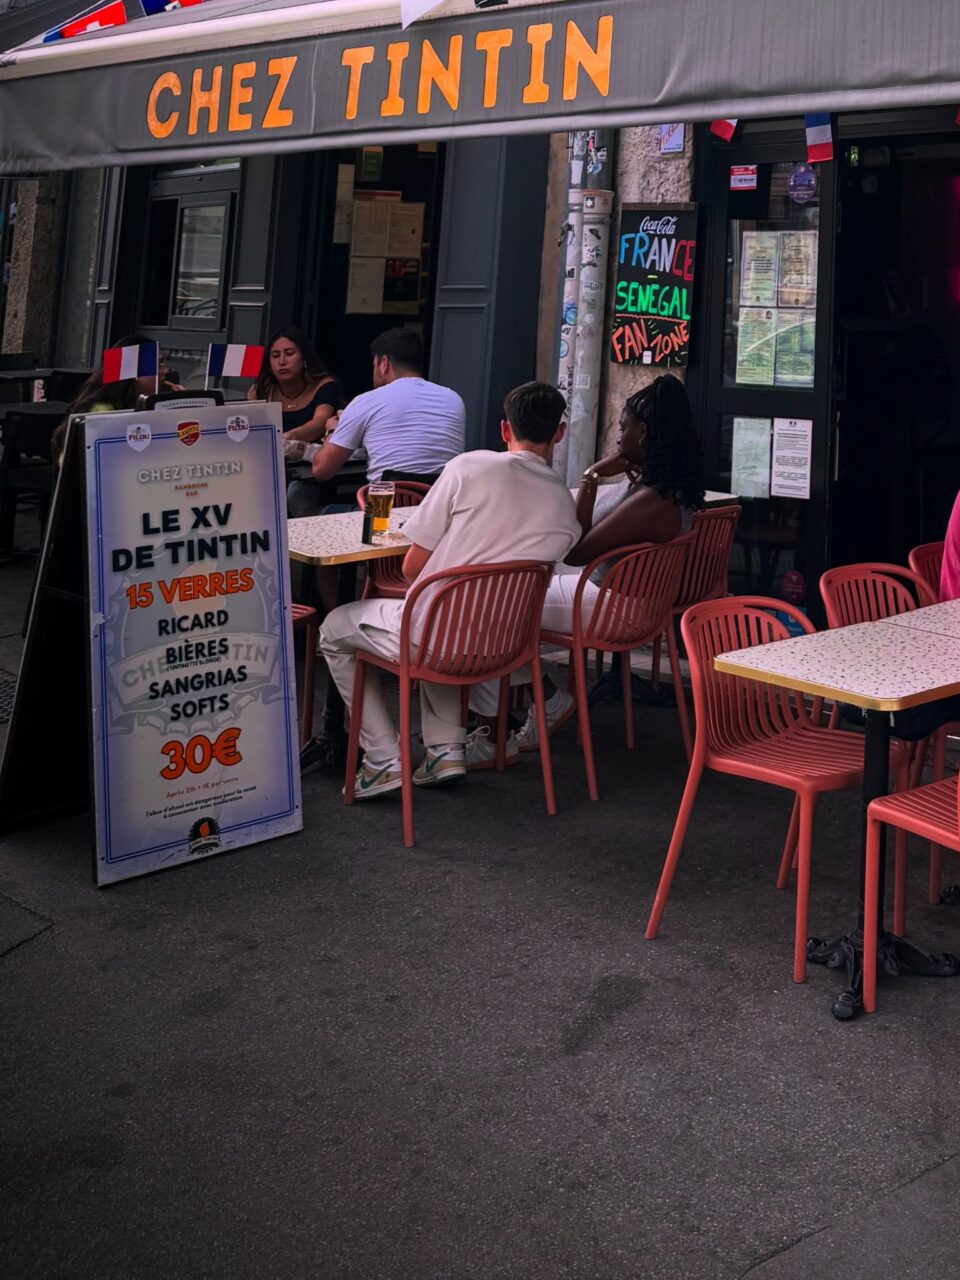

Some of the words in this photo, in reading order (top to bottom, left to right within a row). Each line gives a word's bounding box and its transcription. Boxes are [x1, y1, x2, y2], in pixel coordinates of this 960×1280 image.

[146, 56, 298, 139] CHEZ
[341, 15, 614, 120] TINTIN
[619, 232, 696, 281] FRANCE
[616, 281, 691, 320] SENEGAL
[612, 319, 649, 363] FAN
[650, 321, 690, 362] ZONE
[138, 467, 180, 483] CHEZ
[186, 461, 241, 477] TINTIN
[142, 509, 180, 535] LE
[191, 503, 232, 529] XV
[112, 544, 154, 572] DE
[165, 530, 270, 564] TINTIN
[126, 582, 154, 610] 15
[157, 567, 255, 604] VERRES
[158, 609, 229, 636] RICARD
[165, 637, 229, 665] BIÈRES
[149, 665, 247, 700] SANGRIAS
[170, 693, 230, 721] SOFTS
[160, 727, 243, 780] 30€
[163, 802, 185, 813] d'alcool
[194, 794, 222, 805] dangereux
[223, 791, 236, 799] pour
[166, 790, 184, 799] Après
[168, 807, 199, 818] consommer
